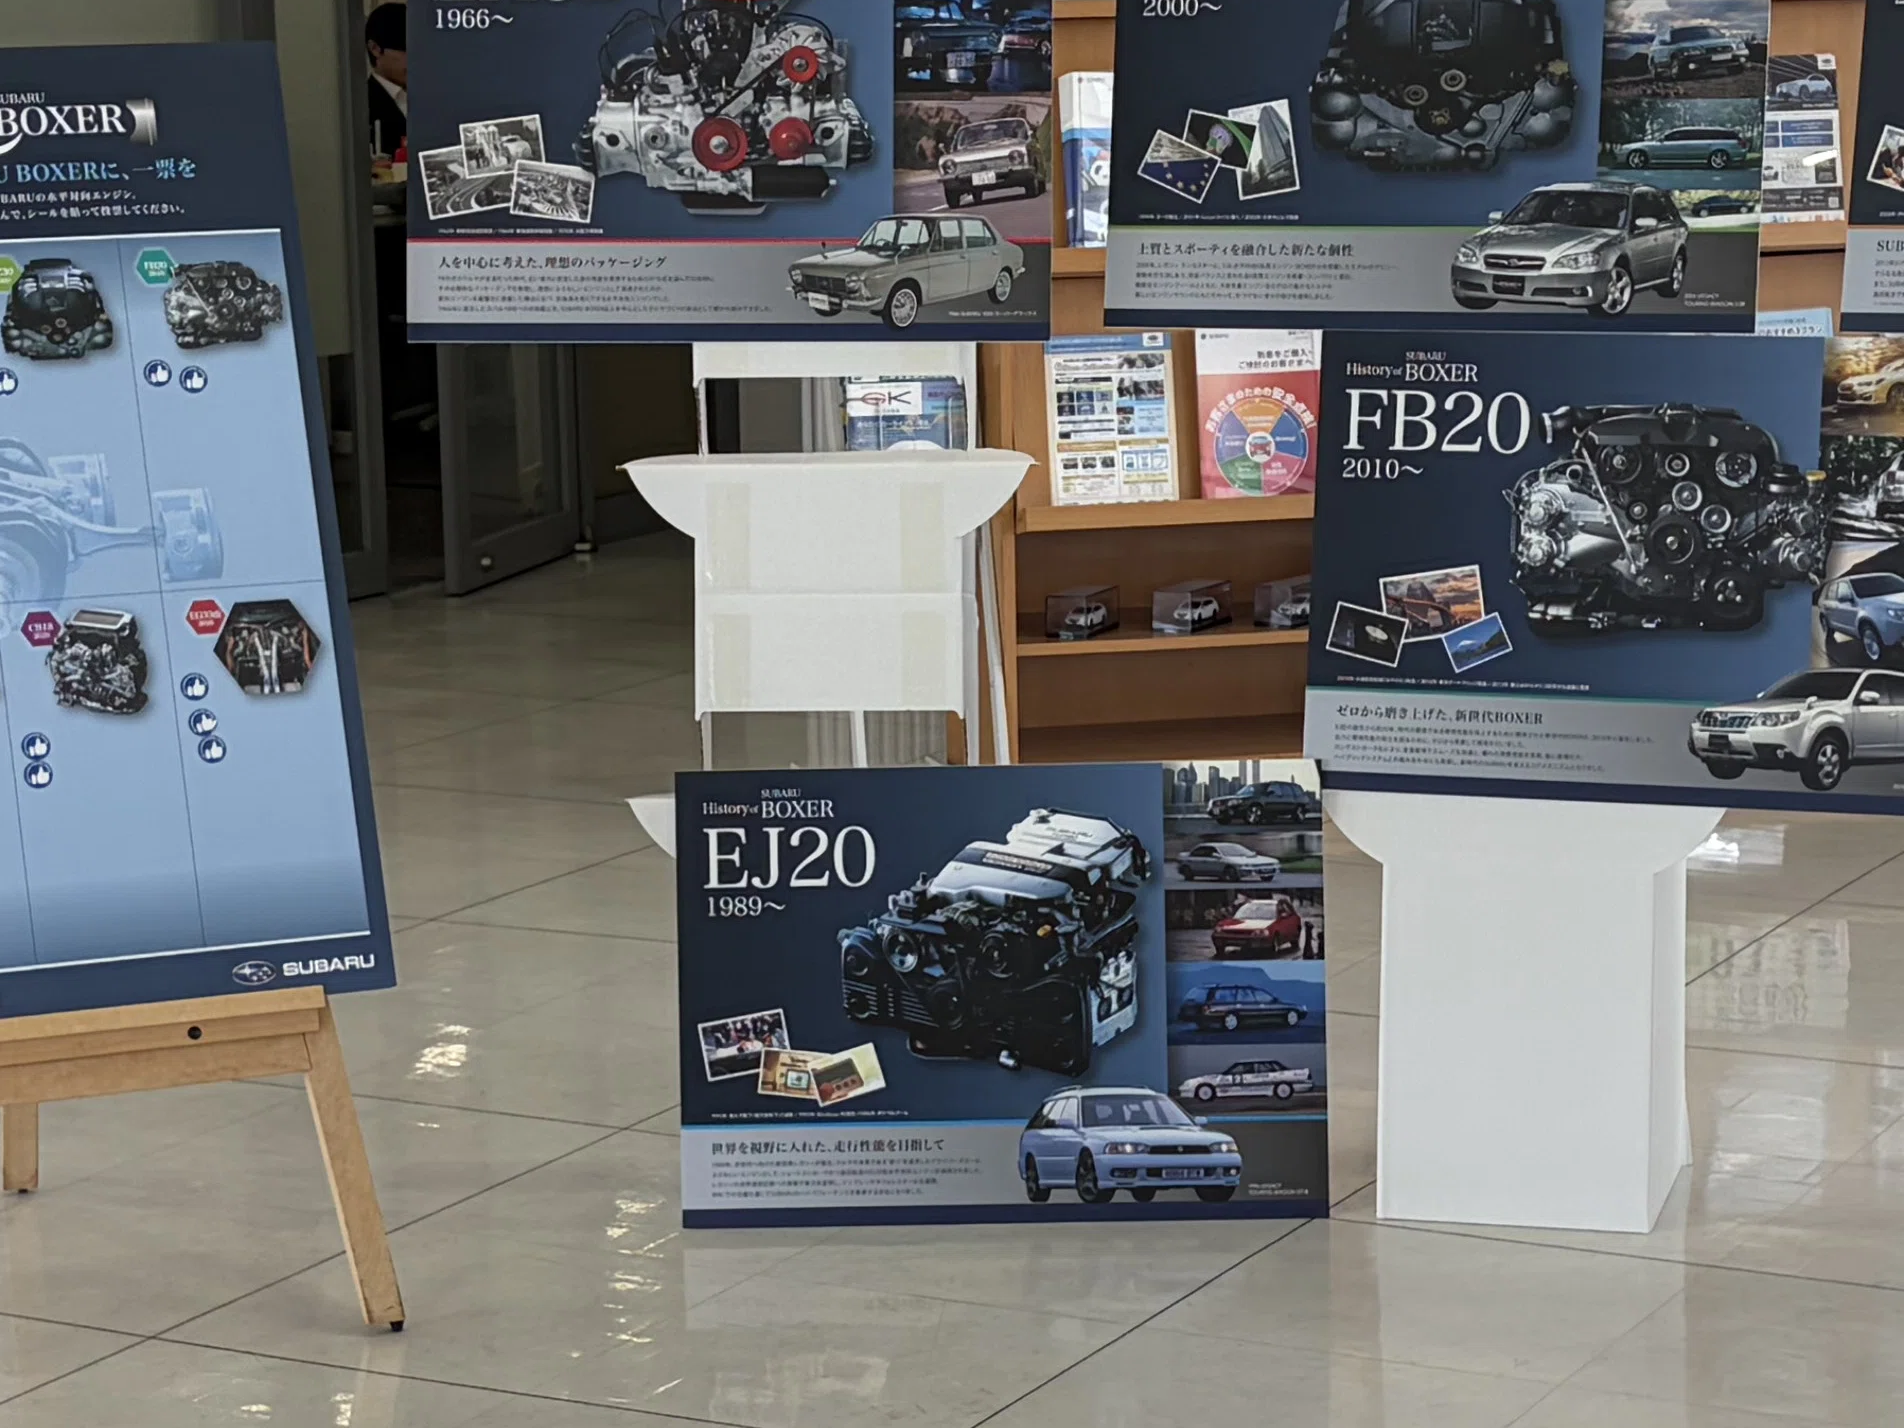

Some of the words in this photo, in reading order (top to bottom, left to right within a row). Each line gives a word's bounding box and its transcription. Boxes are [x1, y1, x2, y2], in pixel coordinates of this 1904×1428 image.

[16, 157, 196, 184] BOXERに、一票を
[1346, 362, 1393, 378] History
[1393, 366, 1403, 375] of
[1405, 363, 1479, 382] BOXER
[1342, 388, 1530, 454] FB20
[702, 802, 750, 817] History
[749, 805, 759, 814] of
[761, 799, 835, 819] BOXER
[702, 825, 876, 890] EJ20
[283, 953, 376, 978] SUBARU
